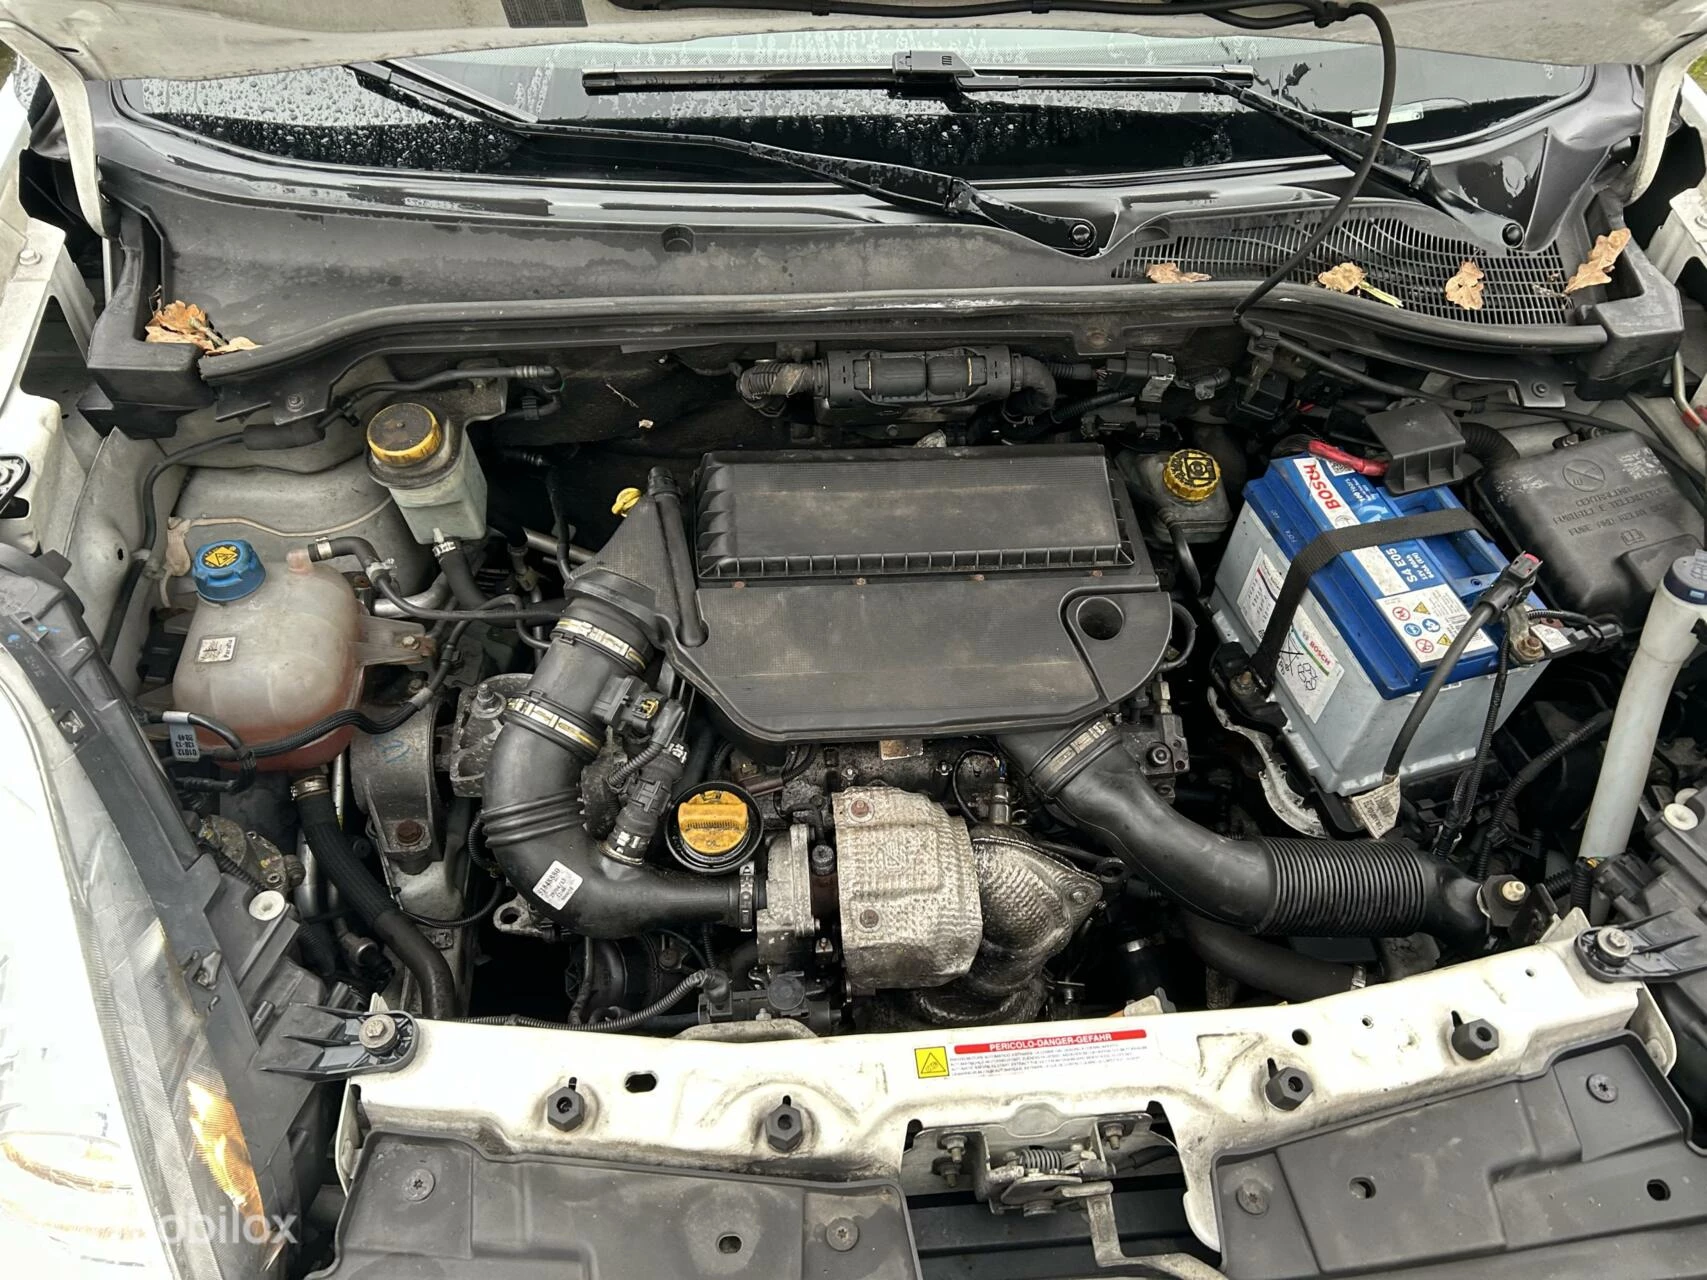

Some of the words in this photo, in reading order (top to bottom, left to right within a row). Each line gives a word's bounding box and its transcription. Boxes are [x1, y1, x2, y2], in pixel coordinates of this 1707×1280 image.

[1303, 464, 1342, 510] BOSCH
[1386, 548, 1407, 567] E05
[1402, 568, 1418, 583] S4
[1310, 641, 1331, 666] BOSCH
[989, 1033, 1112, 1051] PERICOLO-DANGER-GEFAHR
